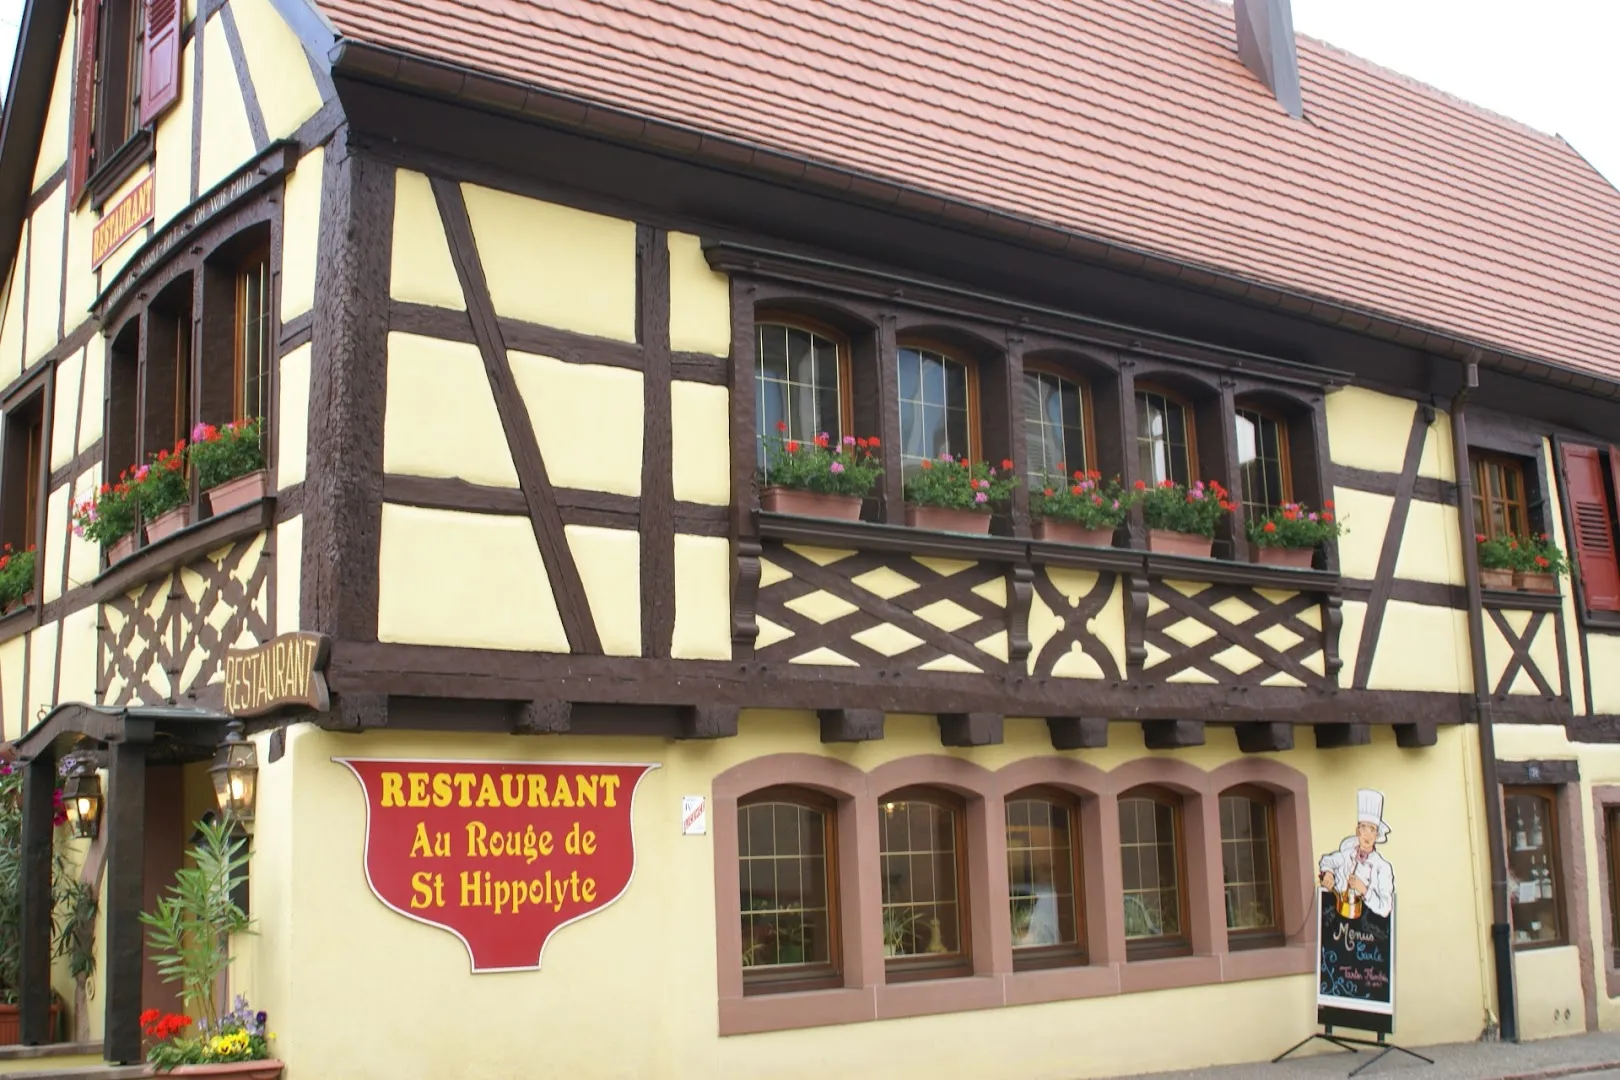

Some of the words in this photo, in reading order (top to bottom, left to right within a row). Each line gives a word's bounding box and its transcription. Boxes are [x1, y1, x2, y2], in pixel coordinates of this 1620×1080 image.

[230, 170, 253, 200] MILD
[93, 176, 153, 263] RESTAURANT
[223, 638, 317, 715] RESTAURANT
[380, 772, 621, 808] RESTAURANT
[409, 821, 451, 859] Au
[465, 820, 554, 865] Rouge
[564, 821, 597, 855] de
[410, 871, 446, 909] St
[459, 869, 597, 915] Hippolyte
[1332, 922, 1375, 952] Menus
